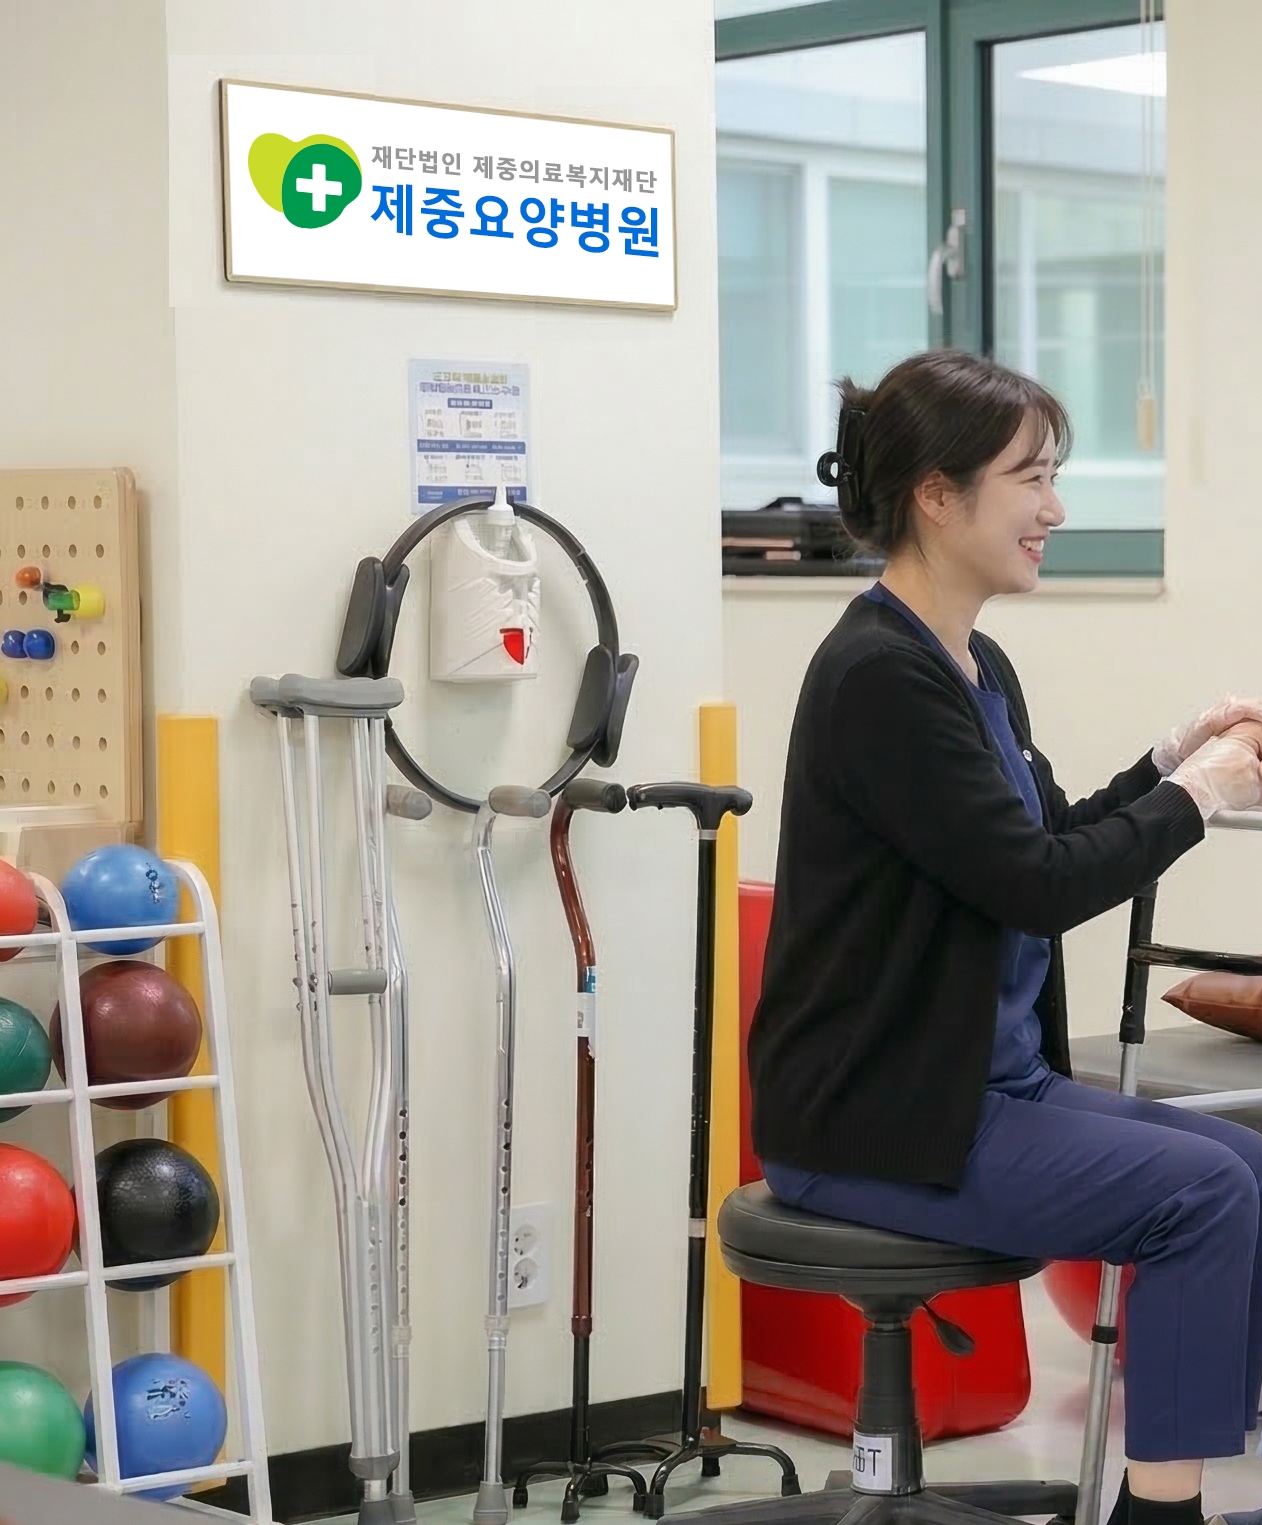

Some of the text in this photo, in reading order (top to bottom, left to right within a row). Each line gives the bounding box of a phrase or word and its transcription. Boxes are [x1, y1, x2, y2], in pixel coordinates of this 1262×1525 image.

[371, 145, 658, 194] 재단법인 제중의료복지재단
[371, 183, 659, 258] 제중요양병원
